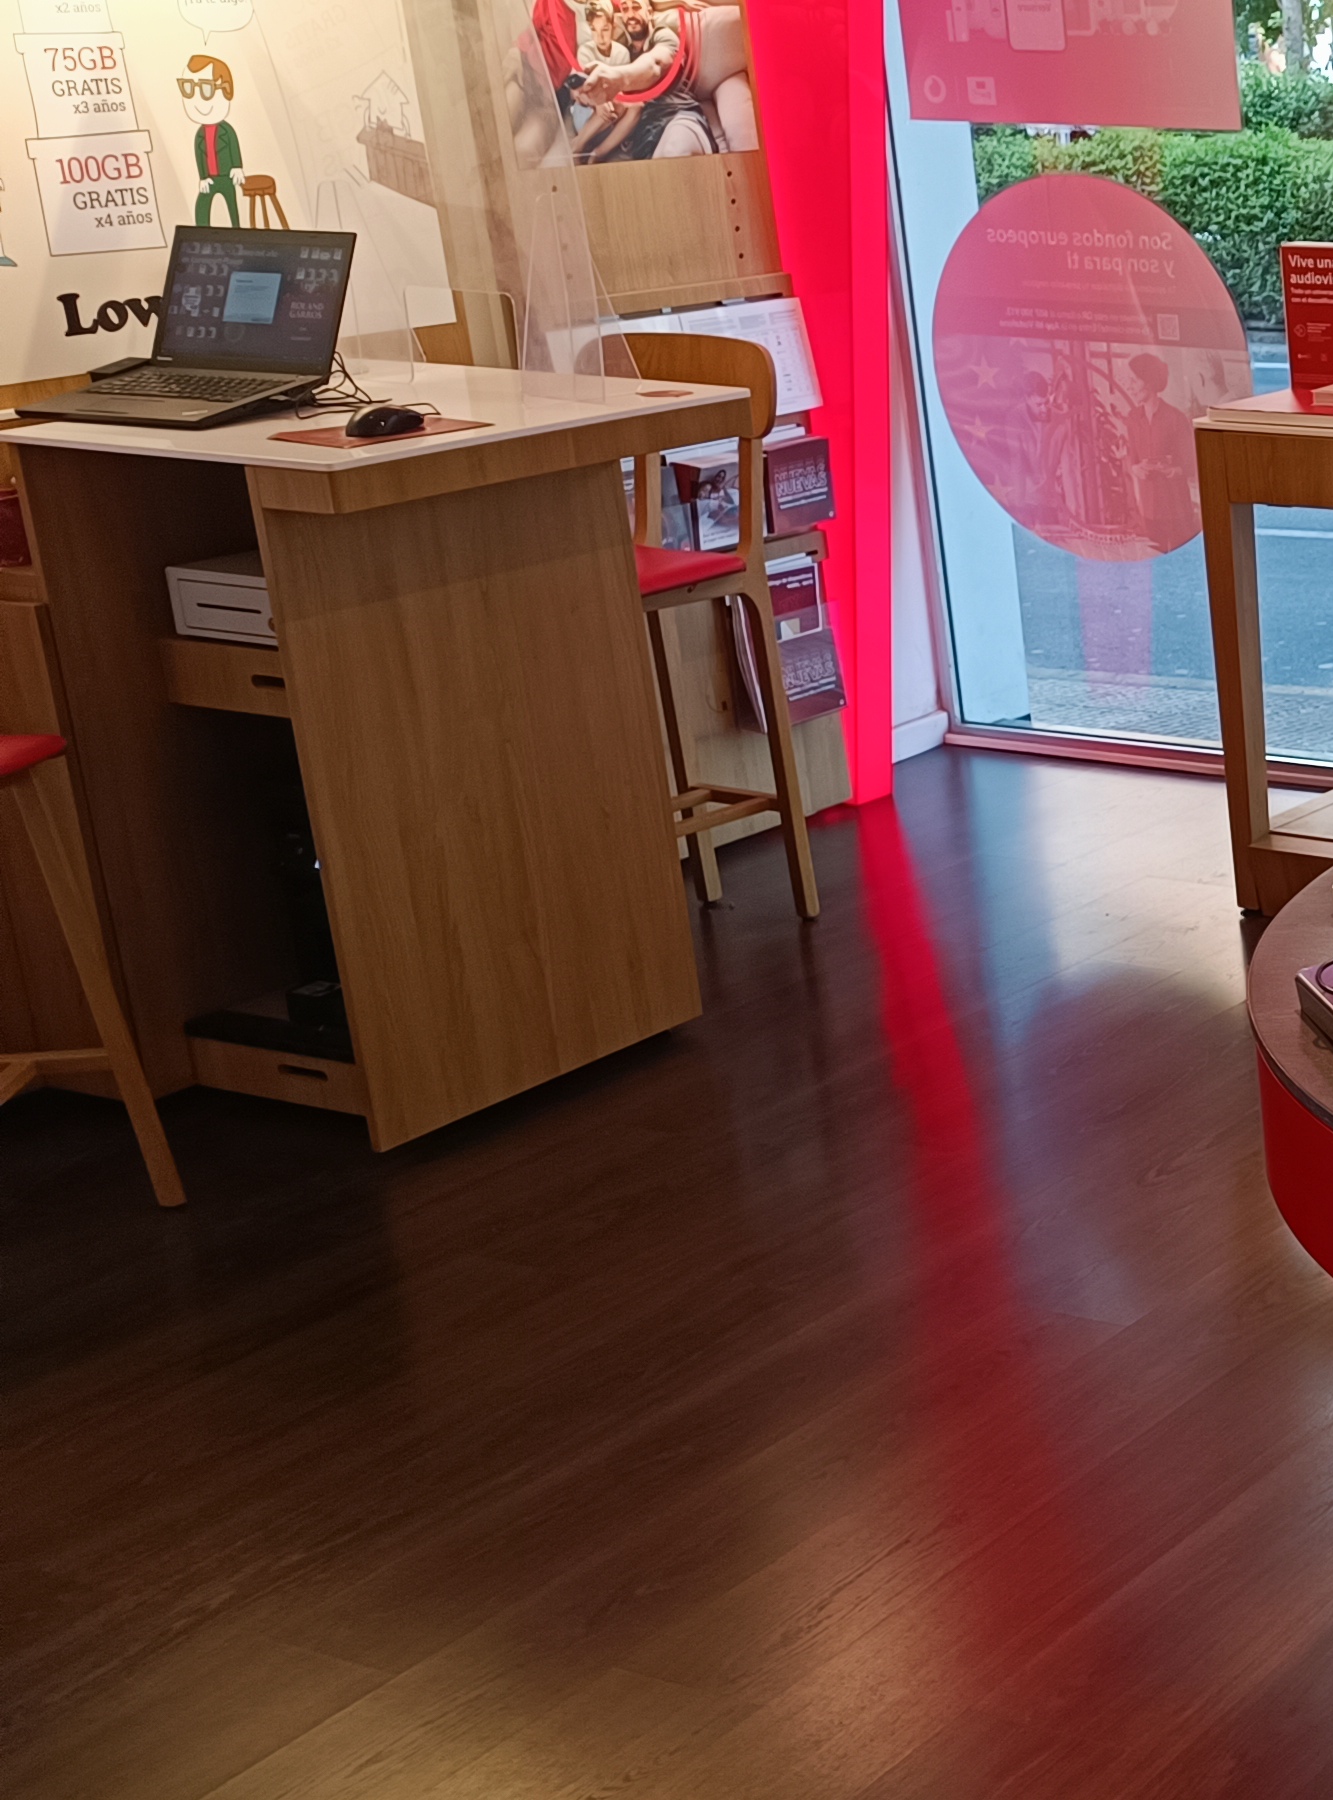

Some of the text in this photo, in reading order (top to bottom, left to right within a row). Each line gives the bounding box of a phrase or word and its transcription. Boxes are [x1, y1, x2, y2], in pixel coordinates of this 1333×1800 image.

[56, 1, 101, 13] x2 años
[44, 46, 117, 72] 75GB
[51, 78, 122, 97] GRATIS
[73, 99, 126, 114] x3 años
[55, 153, 143, 184] 100GB
[73, 187, 149, 210] GRATIS
[95, 211, 153, 228] x4 años
[1288, 254, 1314, 269] Vive
